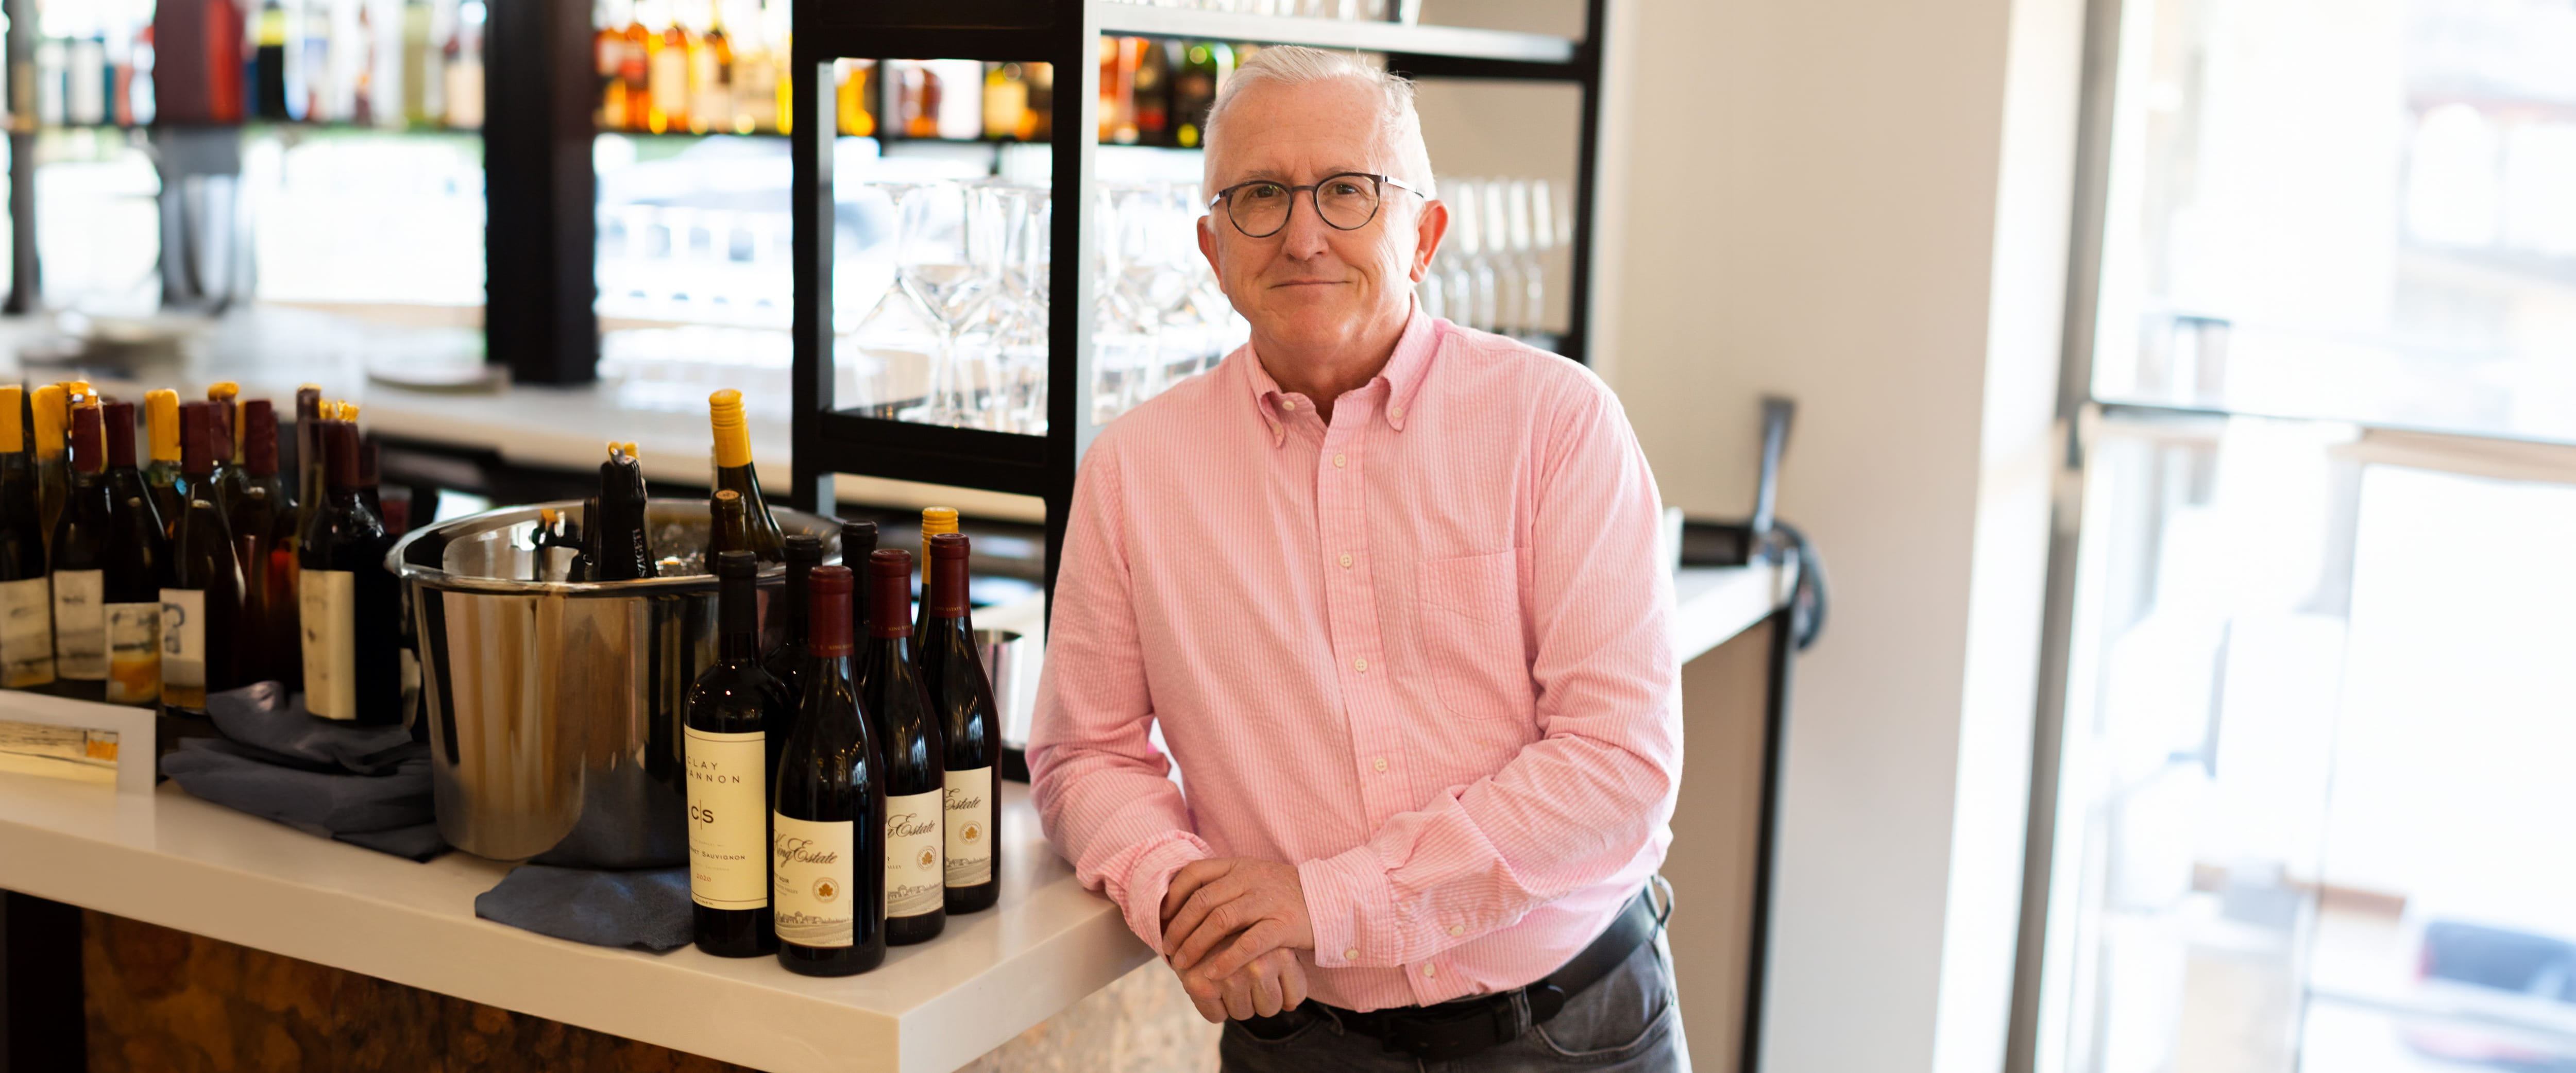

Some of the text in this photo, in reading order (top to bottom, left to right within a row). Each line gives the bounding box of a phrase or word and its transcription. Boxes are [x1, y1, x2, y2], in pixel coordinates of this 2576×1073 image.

[687, 756, 718, 770] CLAY
[945, 788, 981, 811] Estate
[888, 813, 936, 838] Estate
[773, 829, 838, 868] King Estate
[696, 873, 711, 882] 2020
